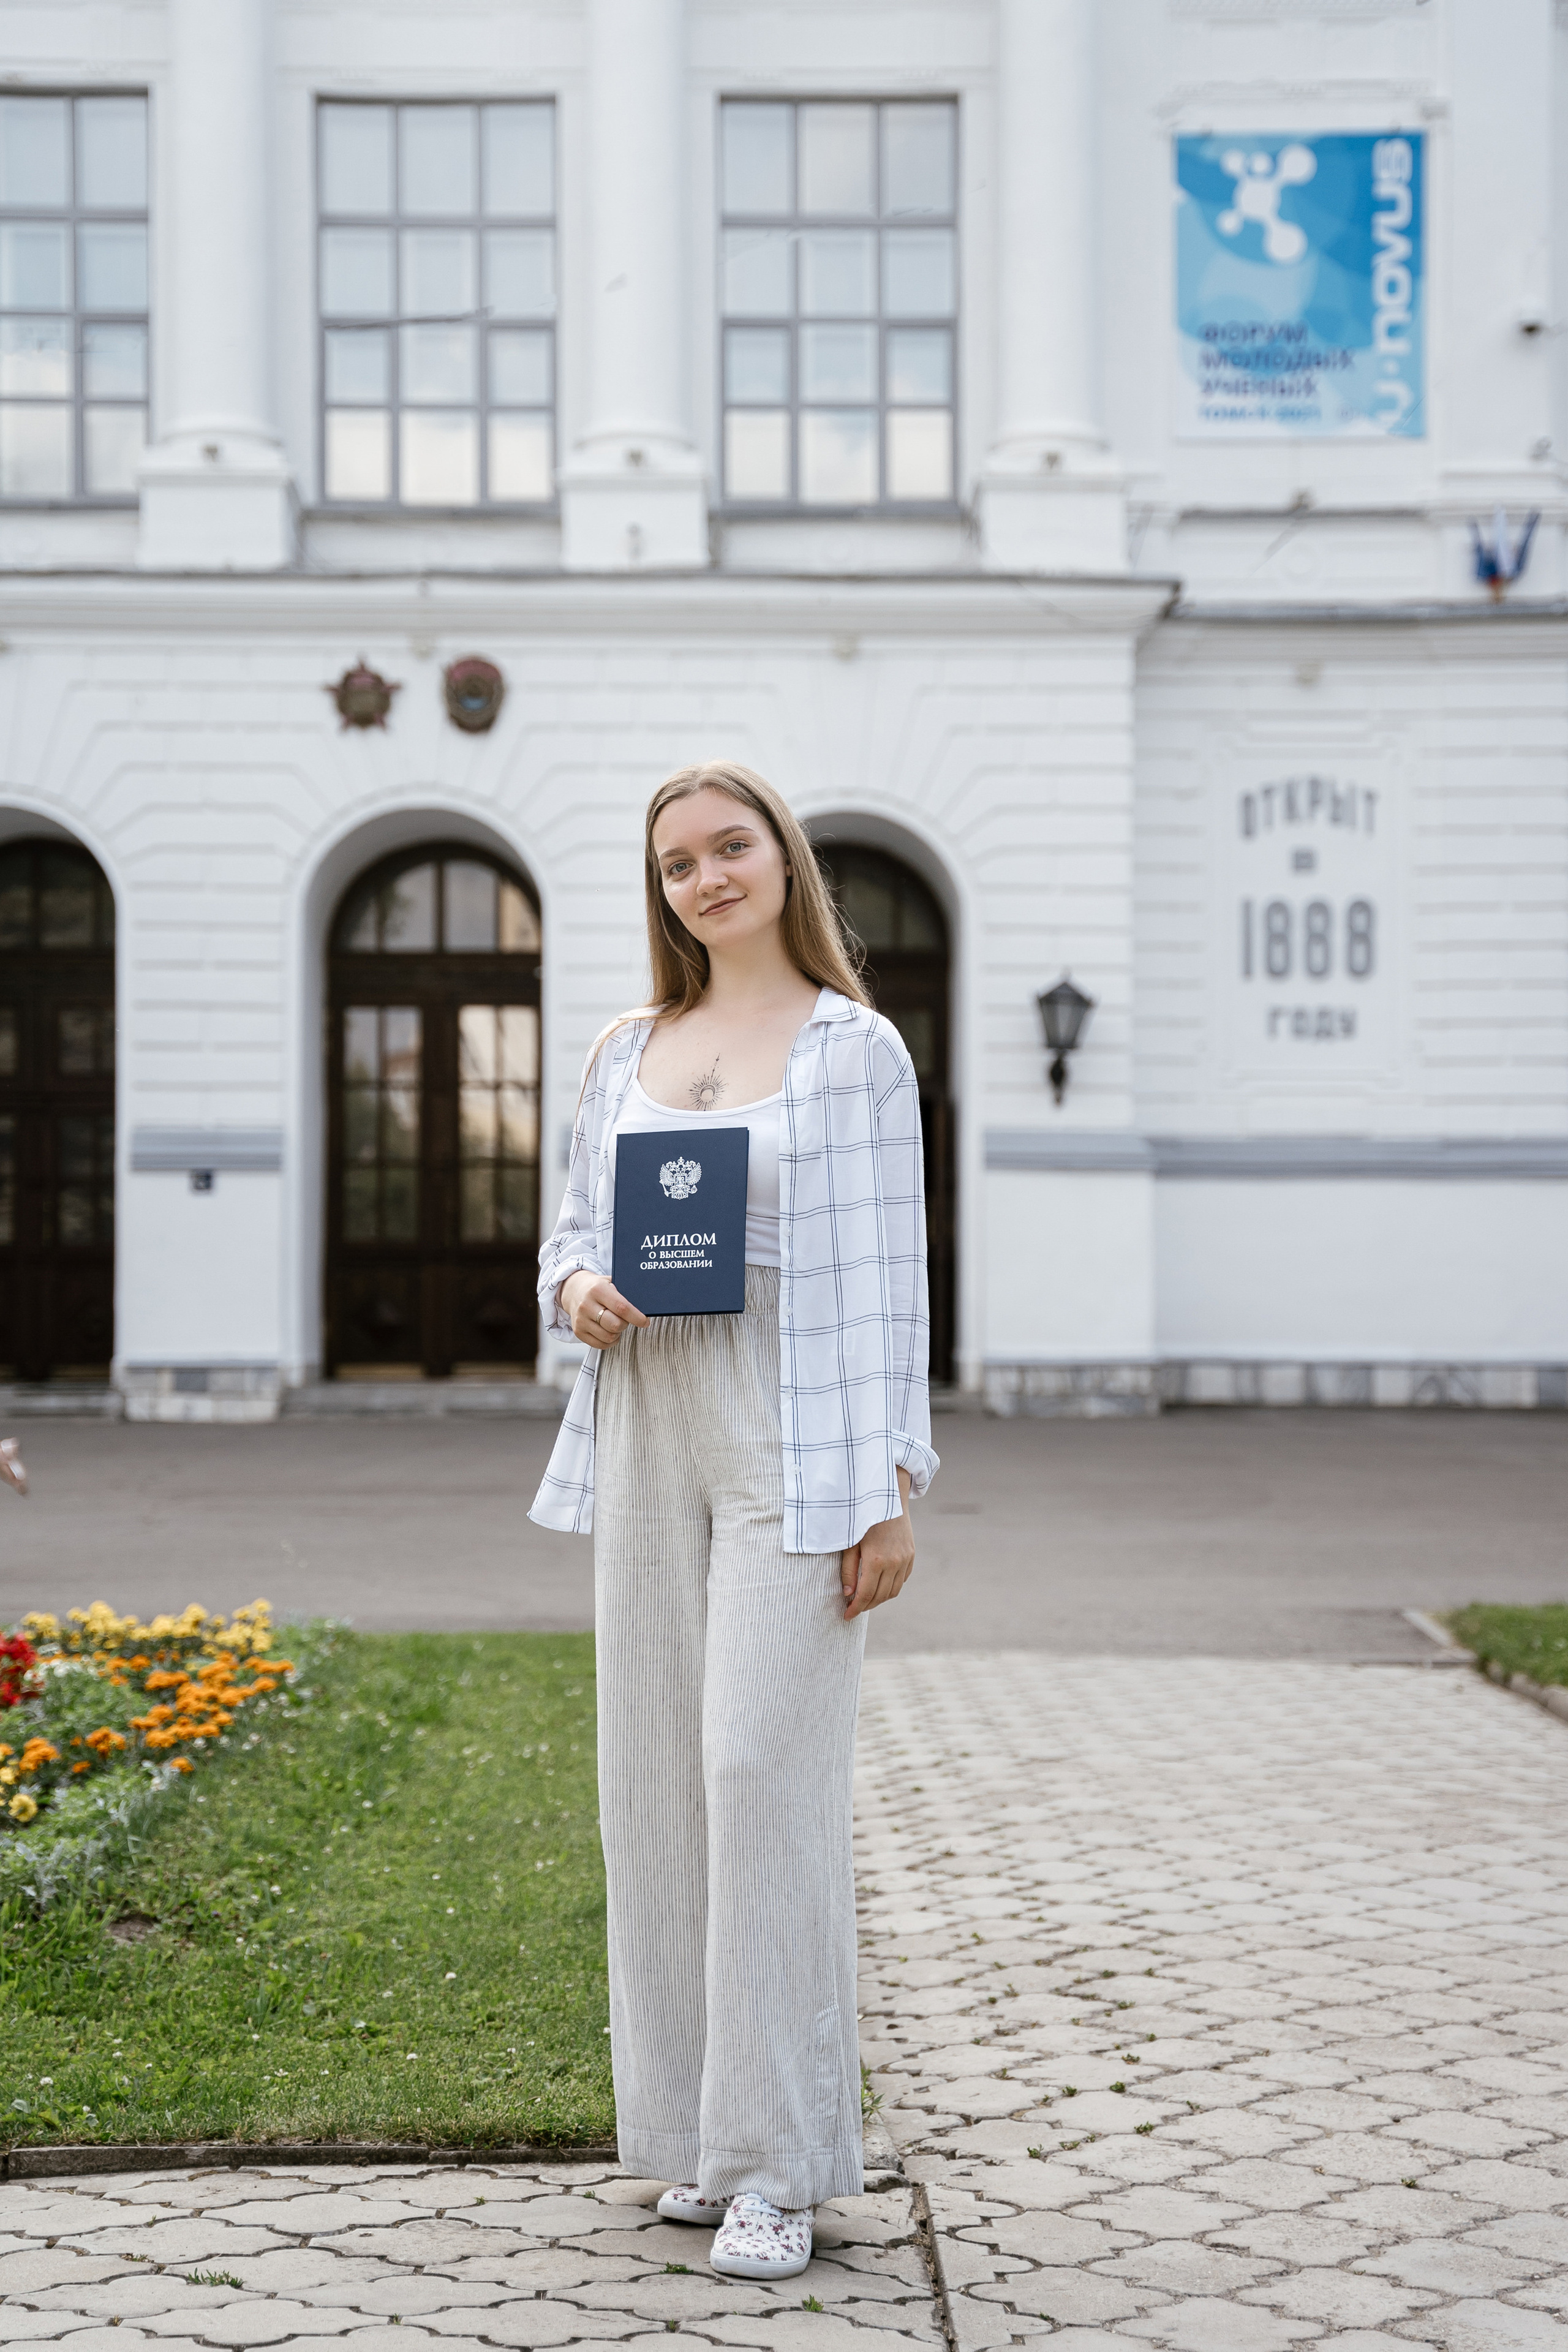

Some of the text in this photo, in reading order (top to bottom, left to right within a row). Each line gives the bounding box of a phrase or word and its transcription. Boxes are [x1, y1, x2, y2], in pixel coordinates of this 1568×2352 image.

[1241, 899, 1374, 980] 1888
[641, 1232, 717, 1250] ДИПЛОМ
[660, 1250, 705, 1259] ВЫСШЕМ
[640, 1259, 713, 1270] ОБРАЗОВАНИИ
